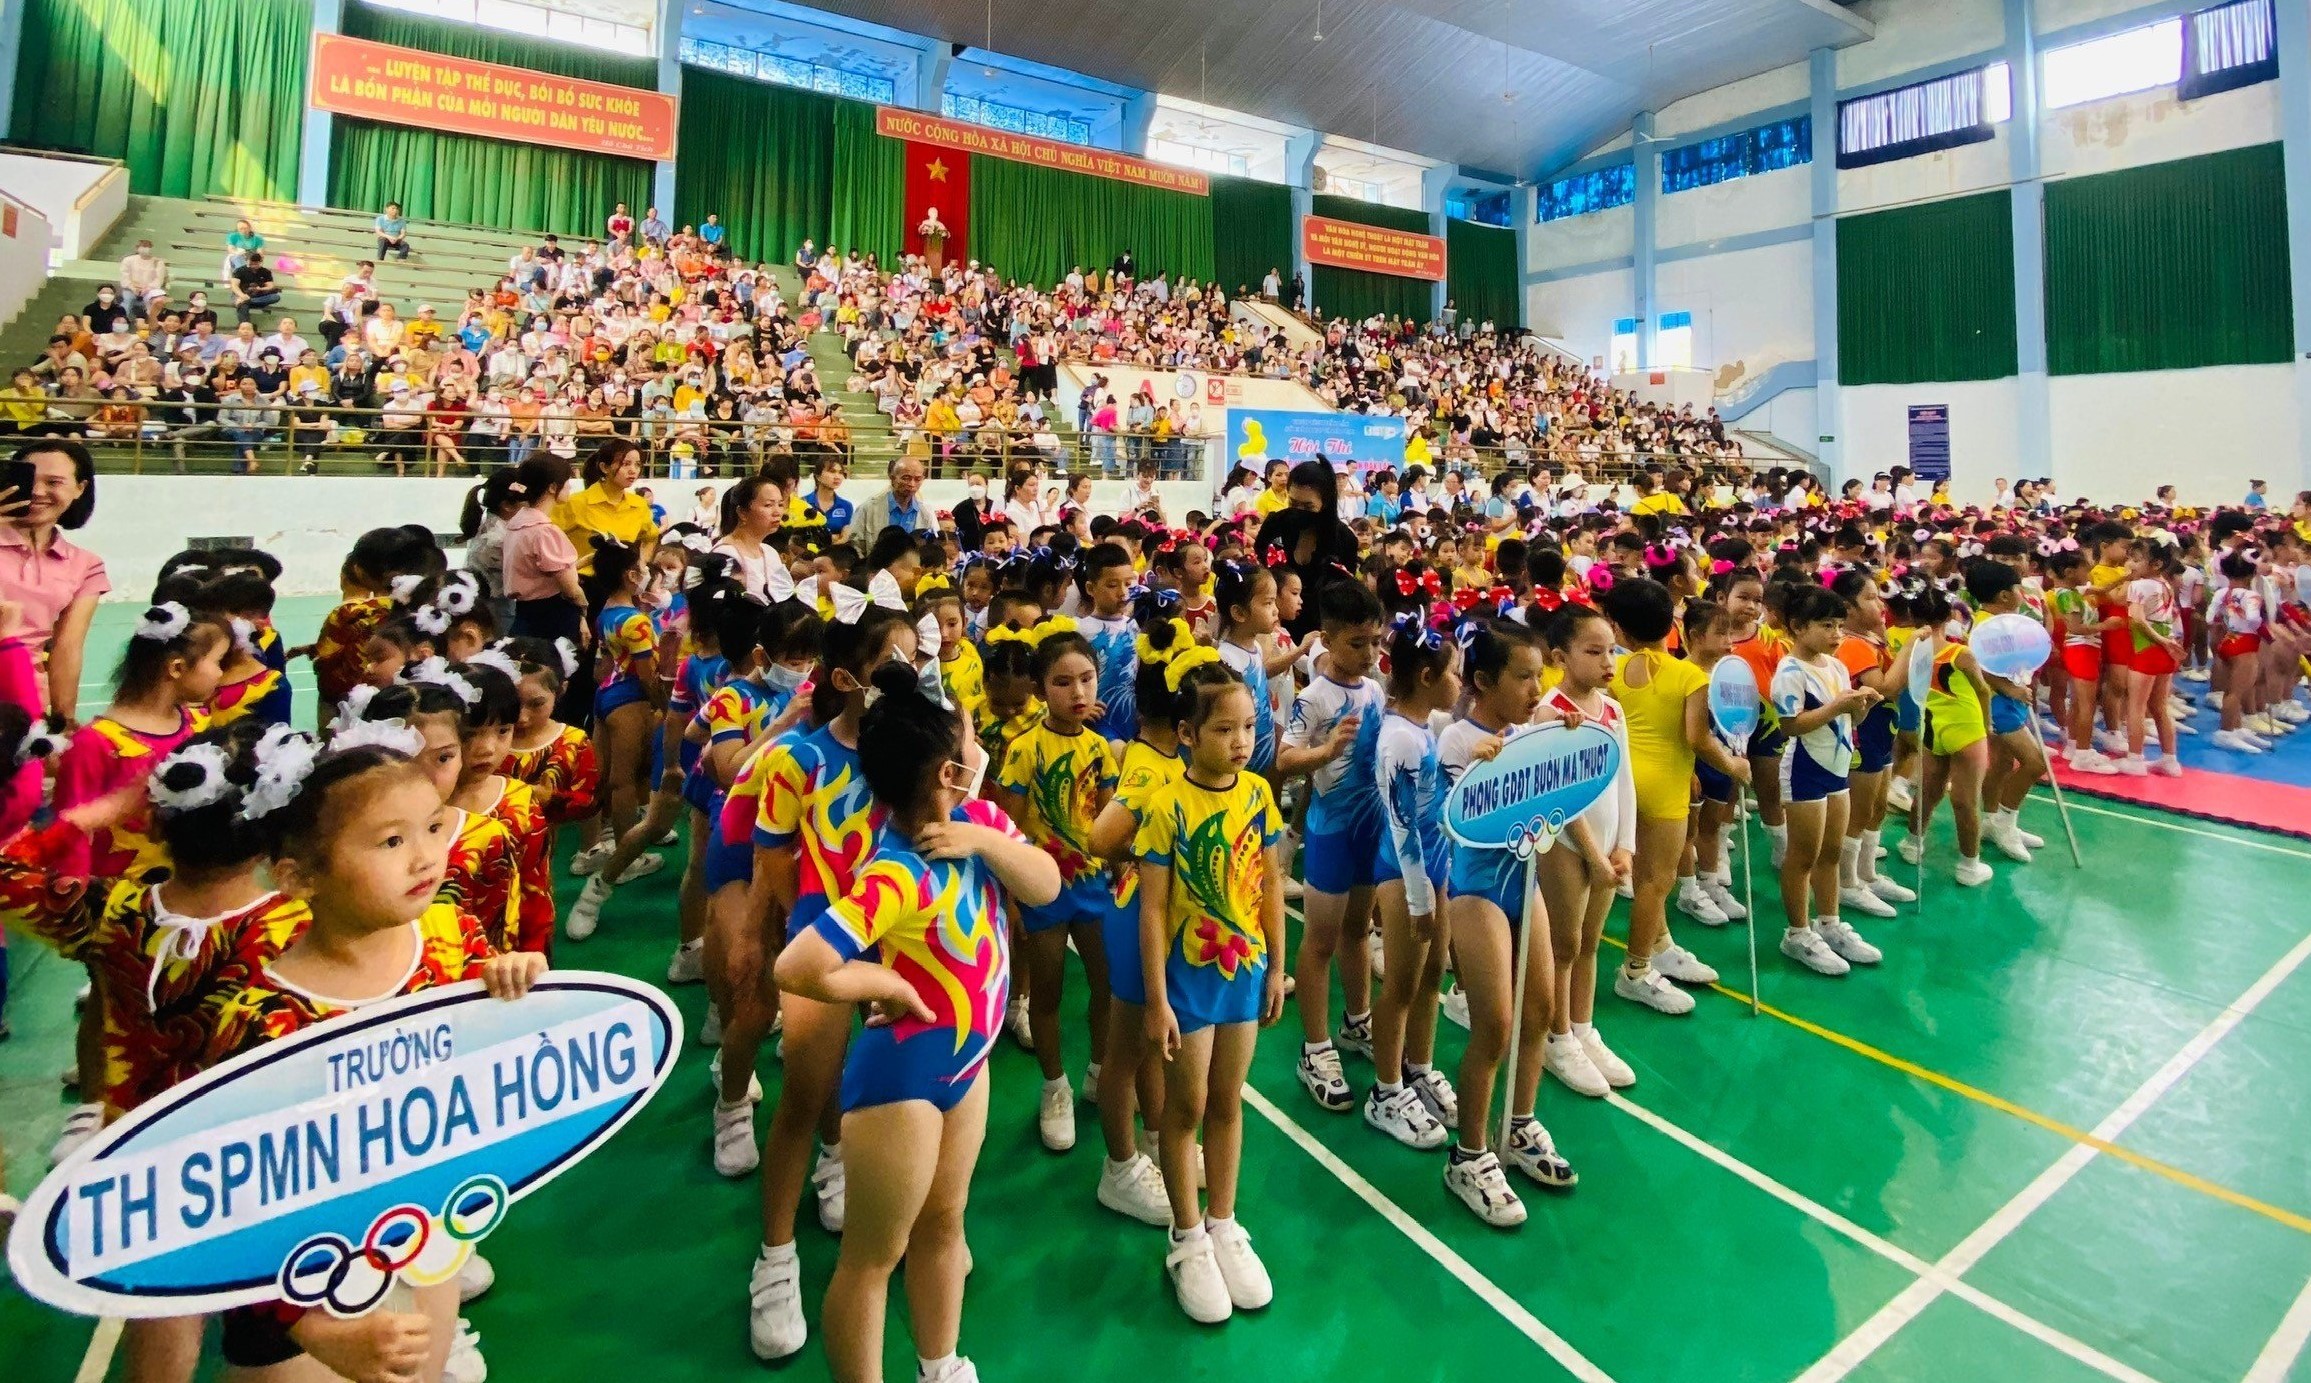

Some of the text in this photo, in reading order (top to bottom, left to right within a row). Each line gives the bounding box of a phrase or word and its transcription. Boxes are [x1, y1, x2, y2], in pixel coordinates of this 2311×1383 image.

[330, 73, 351, 95] LÀ
[354, 73, 388, 101] BỔN
[391, 80, 433, 110] PHẬN
[437, 87, 466, 114] CỦA
[468, 95, 497, 121] MỖI
[501, 102, 546, 127] NGƯỜI
[549, 109, 578, 132] DÂN
[581, 114, 605, 136] YÊU
[385, 58, 431, 82] LUYỆN
[435, 66, 462, 87] TẬP
[465, 70, 490, 93] THỂ
[494, 78, 526, 102] DỤC,
[529, 80, 553, 103] BỒI
[556, 83, 575, 106] BỔ
[578, 90, 603, 111] SỨC
[606, 96, 640, 118] KHỎE
[886, 115, 921, 136] NƯỚC
[924, 123, 959, 143] CỘNG
[962, 129, 988, 148] HÒA
[991, 135, 1009, 153] XÃ
[1011, 140, 1031, 158] HỘI
[1034, 145, 1058, 163] CHỦ
[1061, 150, 1095, 170] NGHĨA
[1096, 157, 1122, 175] VIỆT
[1124, 163, 1146, 180] NAM
[1148, 168, 1176, 185] MUÔN
[1288, 437, 1353, 457] Hội Thi
[1562, 752, 1577, 787] MA
[328, 1024, 453, 1092] TRƯỜNG
[80, 1021, 637, 1258] TH SPMN HOA HỒNG
